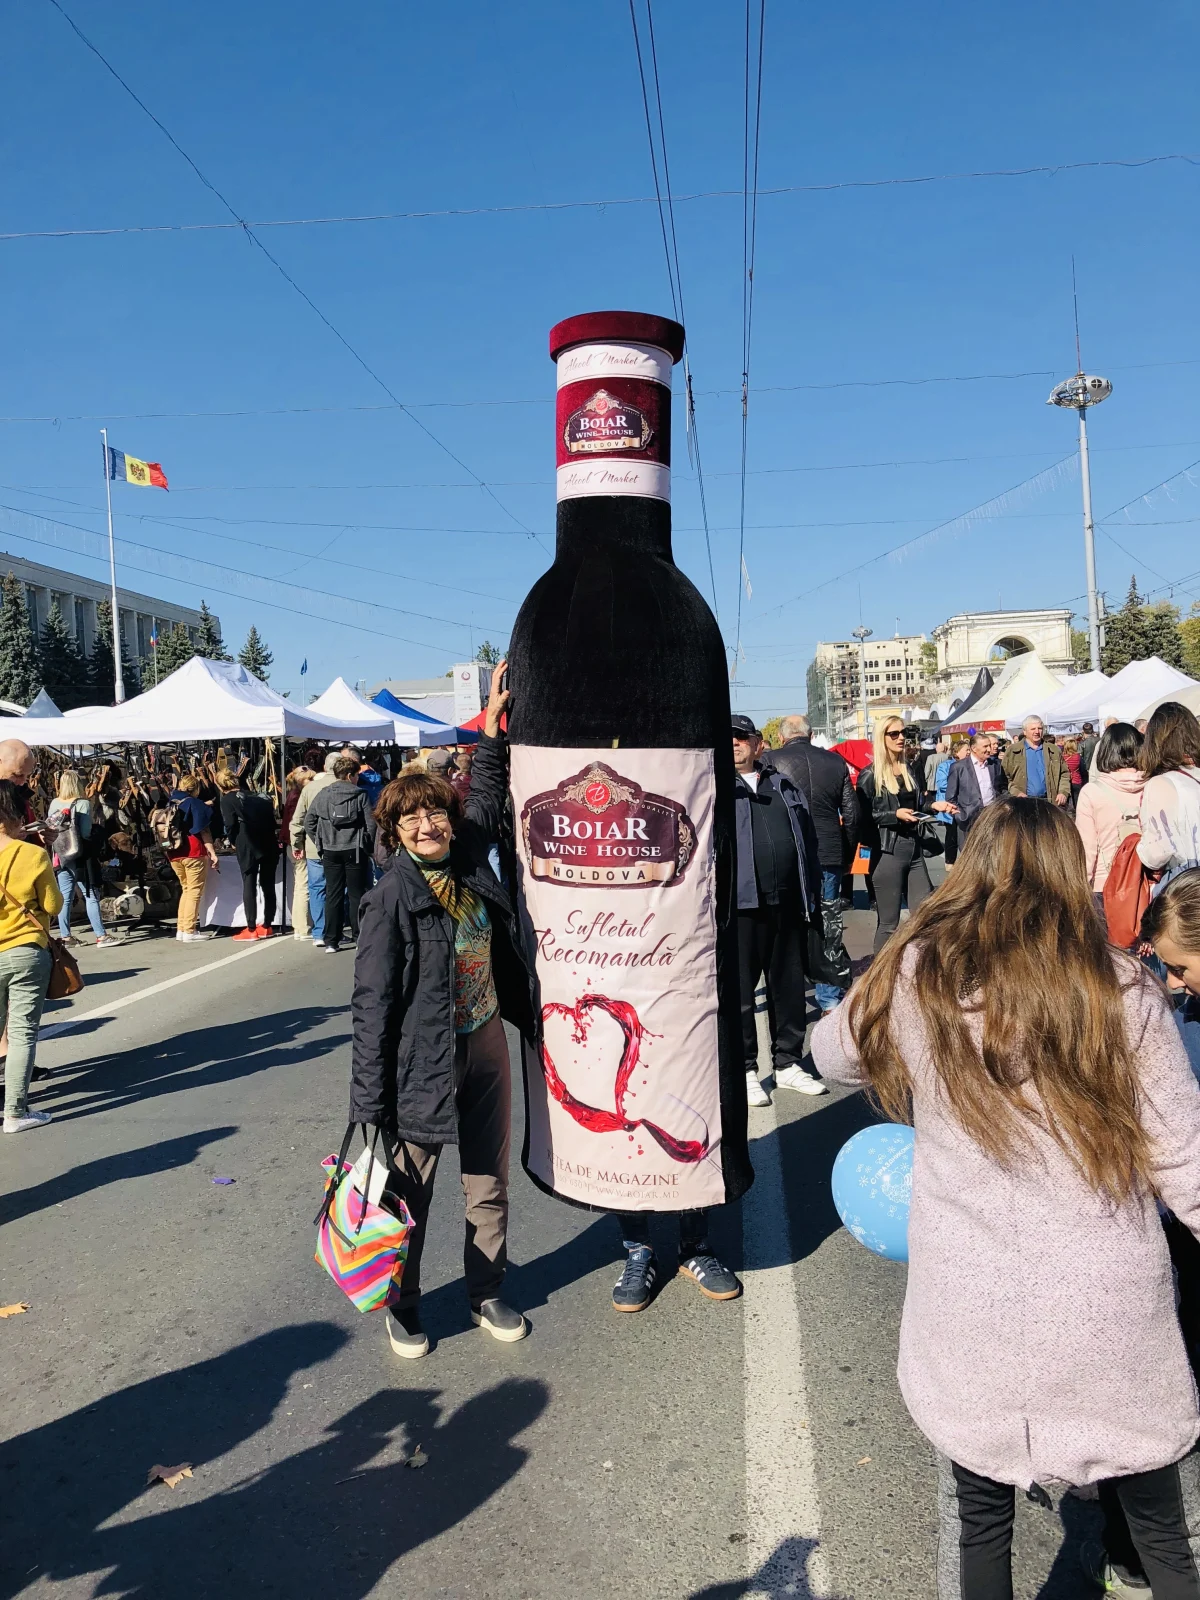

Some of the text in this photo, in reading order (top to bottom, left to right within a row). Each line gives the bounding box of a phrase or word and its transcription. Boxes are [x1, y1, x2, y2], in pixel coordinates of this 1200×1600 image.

[594, 351, 639, 366] Market
[579, 415, 628, 431] BOIAR
[575, 428, 634, 439] WINE HOUSE
[581, 441, 627, 449] MOLDOVA
[593, 469, 640, 484] Market
[551, 814, 650, 842] BOIAR
[543, 841, 662, 857] WINE HOUSE
[553, 866, 646, 881] MOLDOVA
[565, 909, 656, 944] Sufletul
[532, 928, 677, 969] Recomandă
[576, 1164, 592, 1179] DE
[596, 1170, 679, 1186] MAGAZINE
